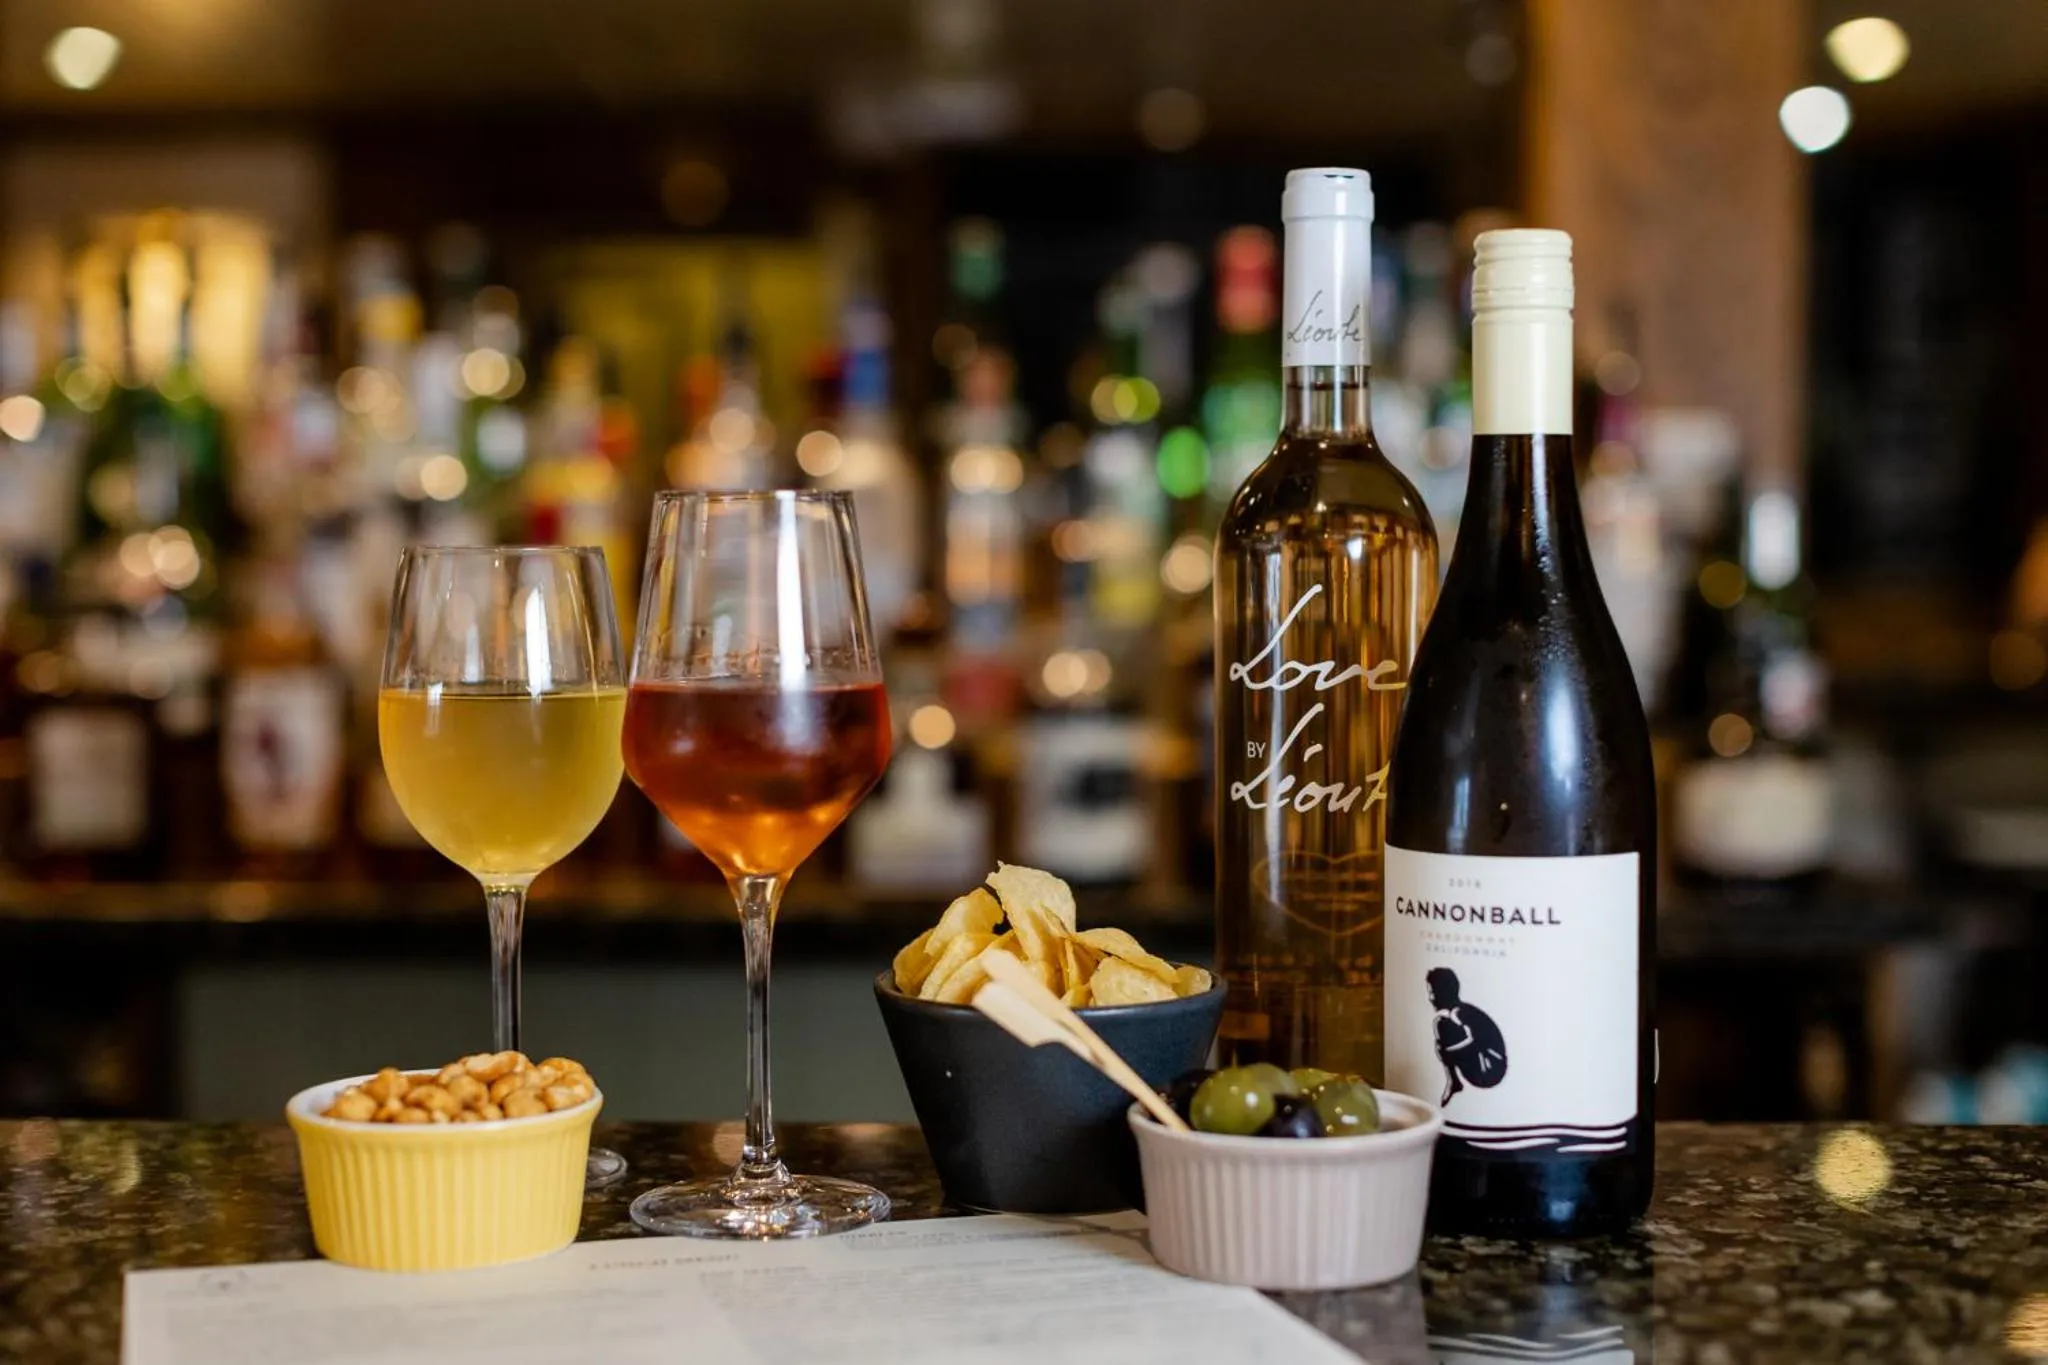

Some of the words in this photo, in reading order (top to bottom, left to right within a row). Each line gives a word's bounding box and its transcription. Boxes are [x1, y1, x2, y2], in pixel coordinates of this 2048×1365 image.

[1229, 583, 1408, 691] Love
[1247, 741, 1267, 758] BY
[1396, 896, 1561, 925] CANNONBALL
